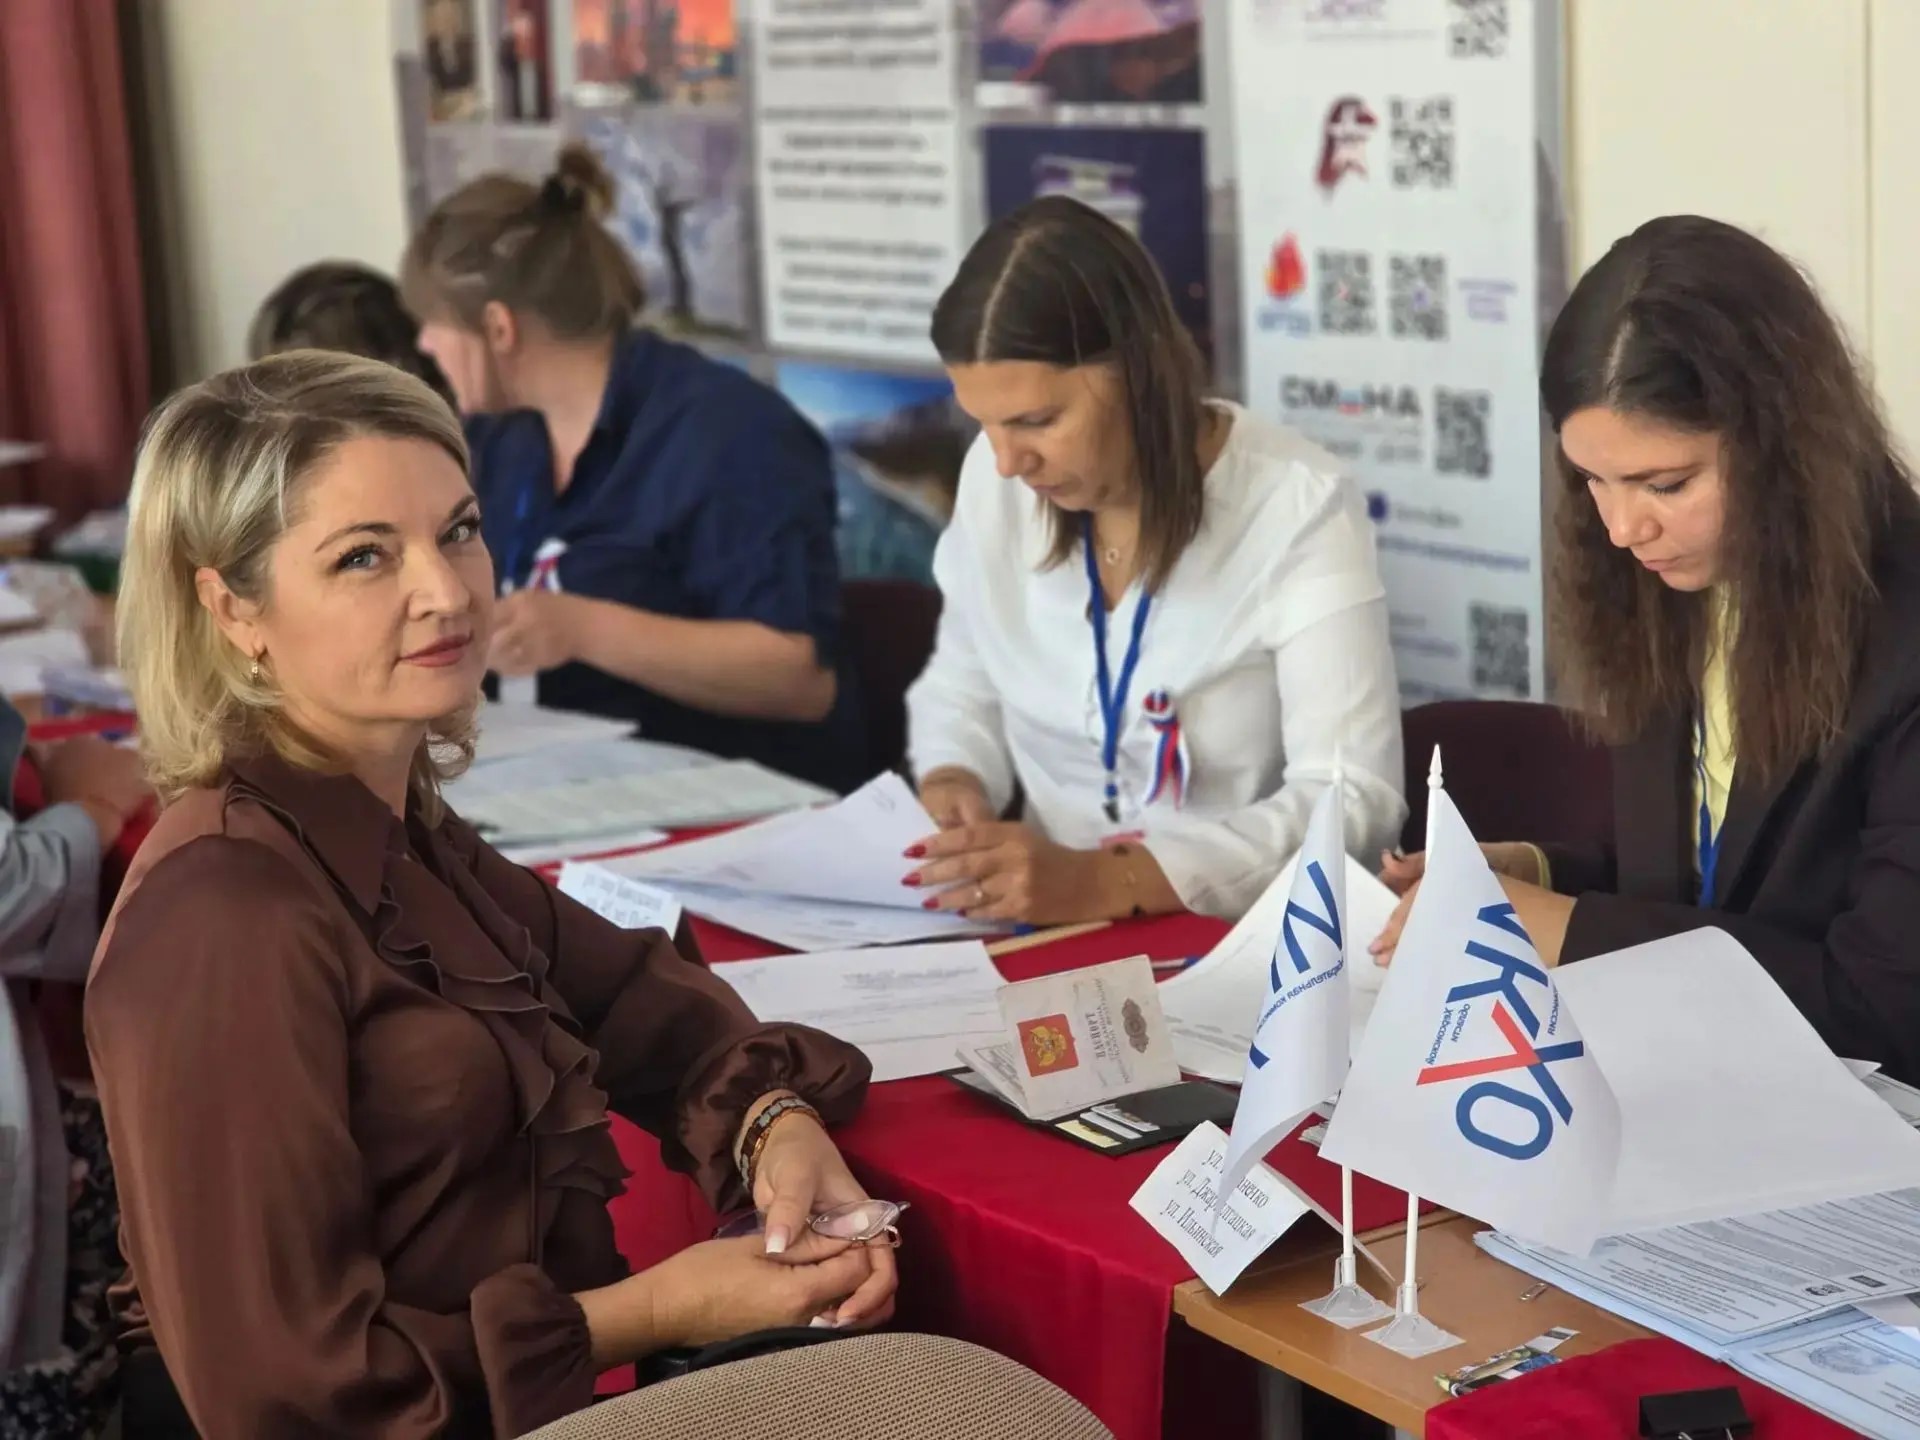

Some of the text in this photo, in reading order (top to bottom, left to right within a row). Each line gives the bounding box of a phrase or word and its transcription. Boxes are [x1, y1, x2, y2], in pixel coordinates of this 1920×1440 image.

[1085, 1013, 1106, 1058] ПАСПОРТ
[1202, 1150, 1223, 1168] ул.
[1159, 1200, 1224, 1258] ул. Ильинская
[1176, 1169, 1257, 1241] ул. Джарлгацкая
